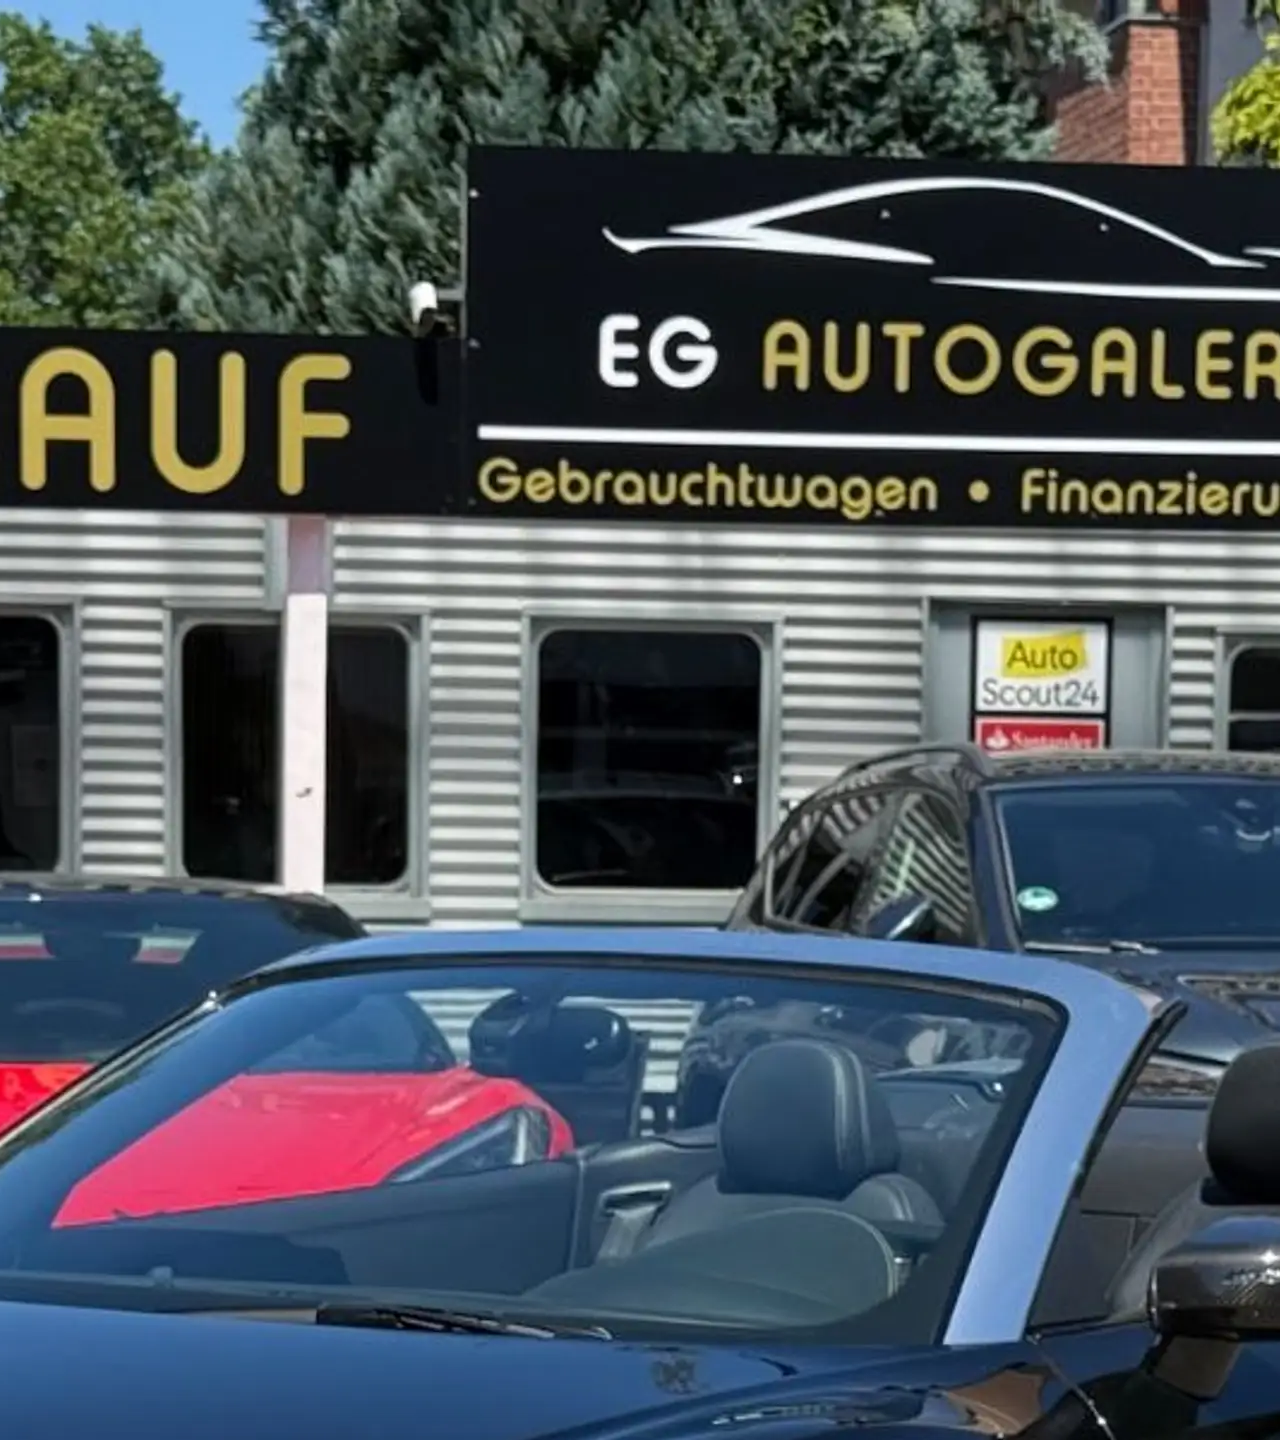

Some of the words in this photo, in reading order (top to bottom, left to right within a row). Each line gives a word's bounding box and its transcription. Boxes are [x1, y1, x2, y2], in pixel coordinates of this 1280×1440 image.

[598, 313, 719, 390] EG
[478, 456, 938, 520] Gebrauchtwagen
[1006, 639, 1079, 671] Auto
[982, 677, 1100, 708] Scout24
